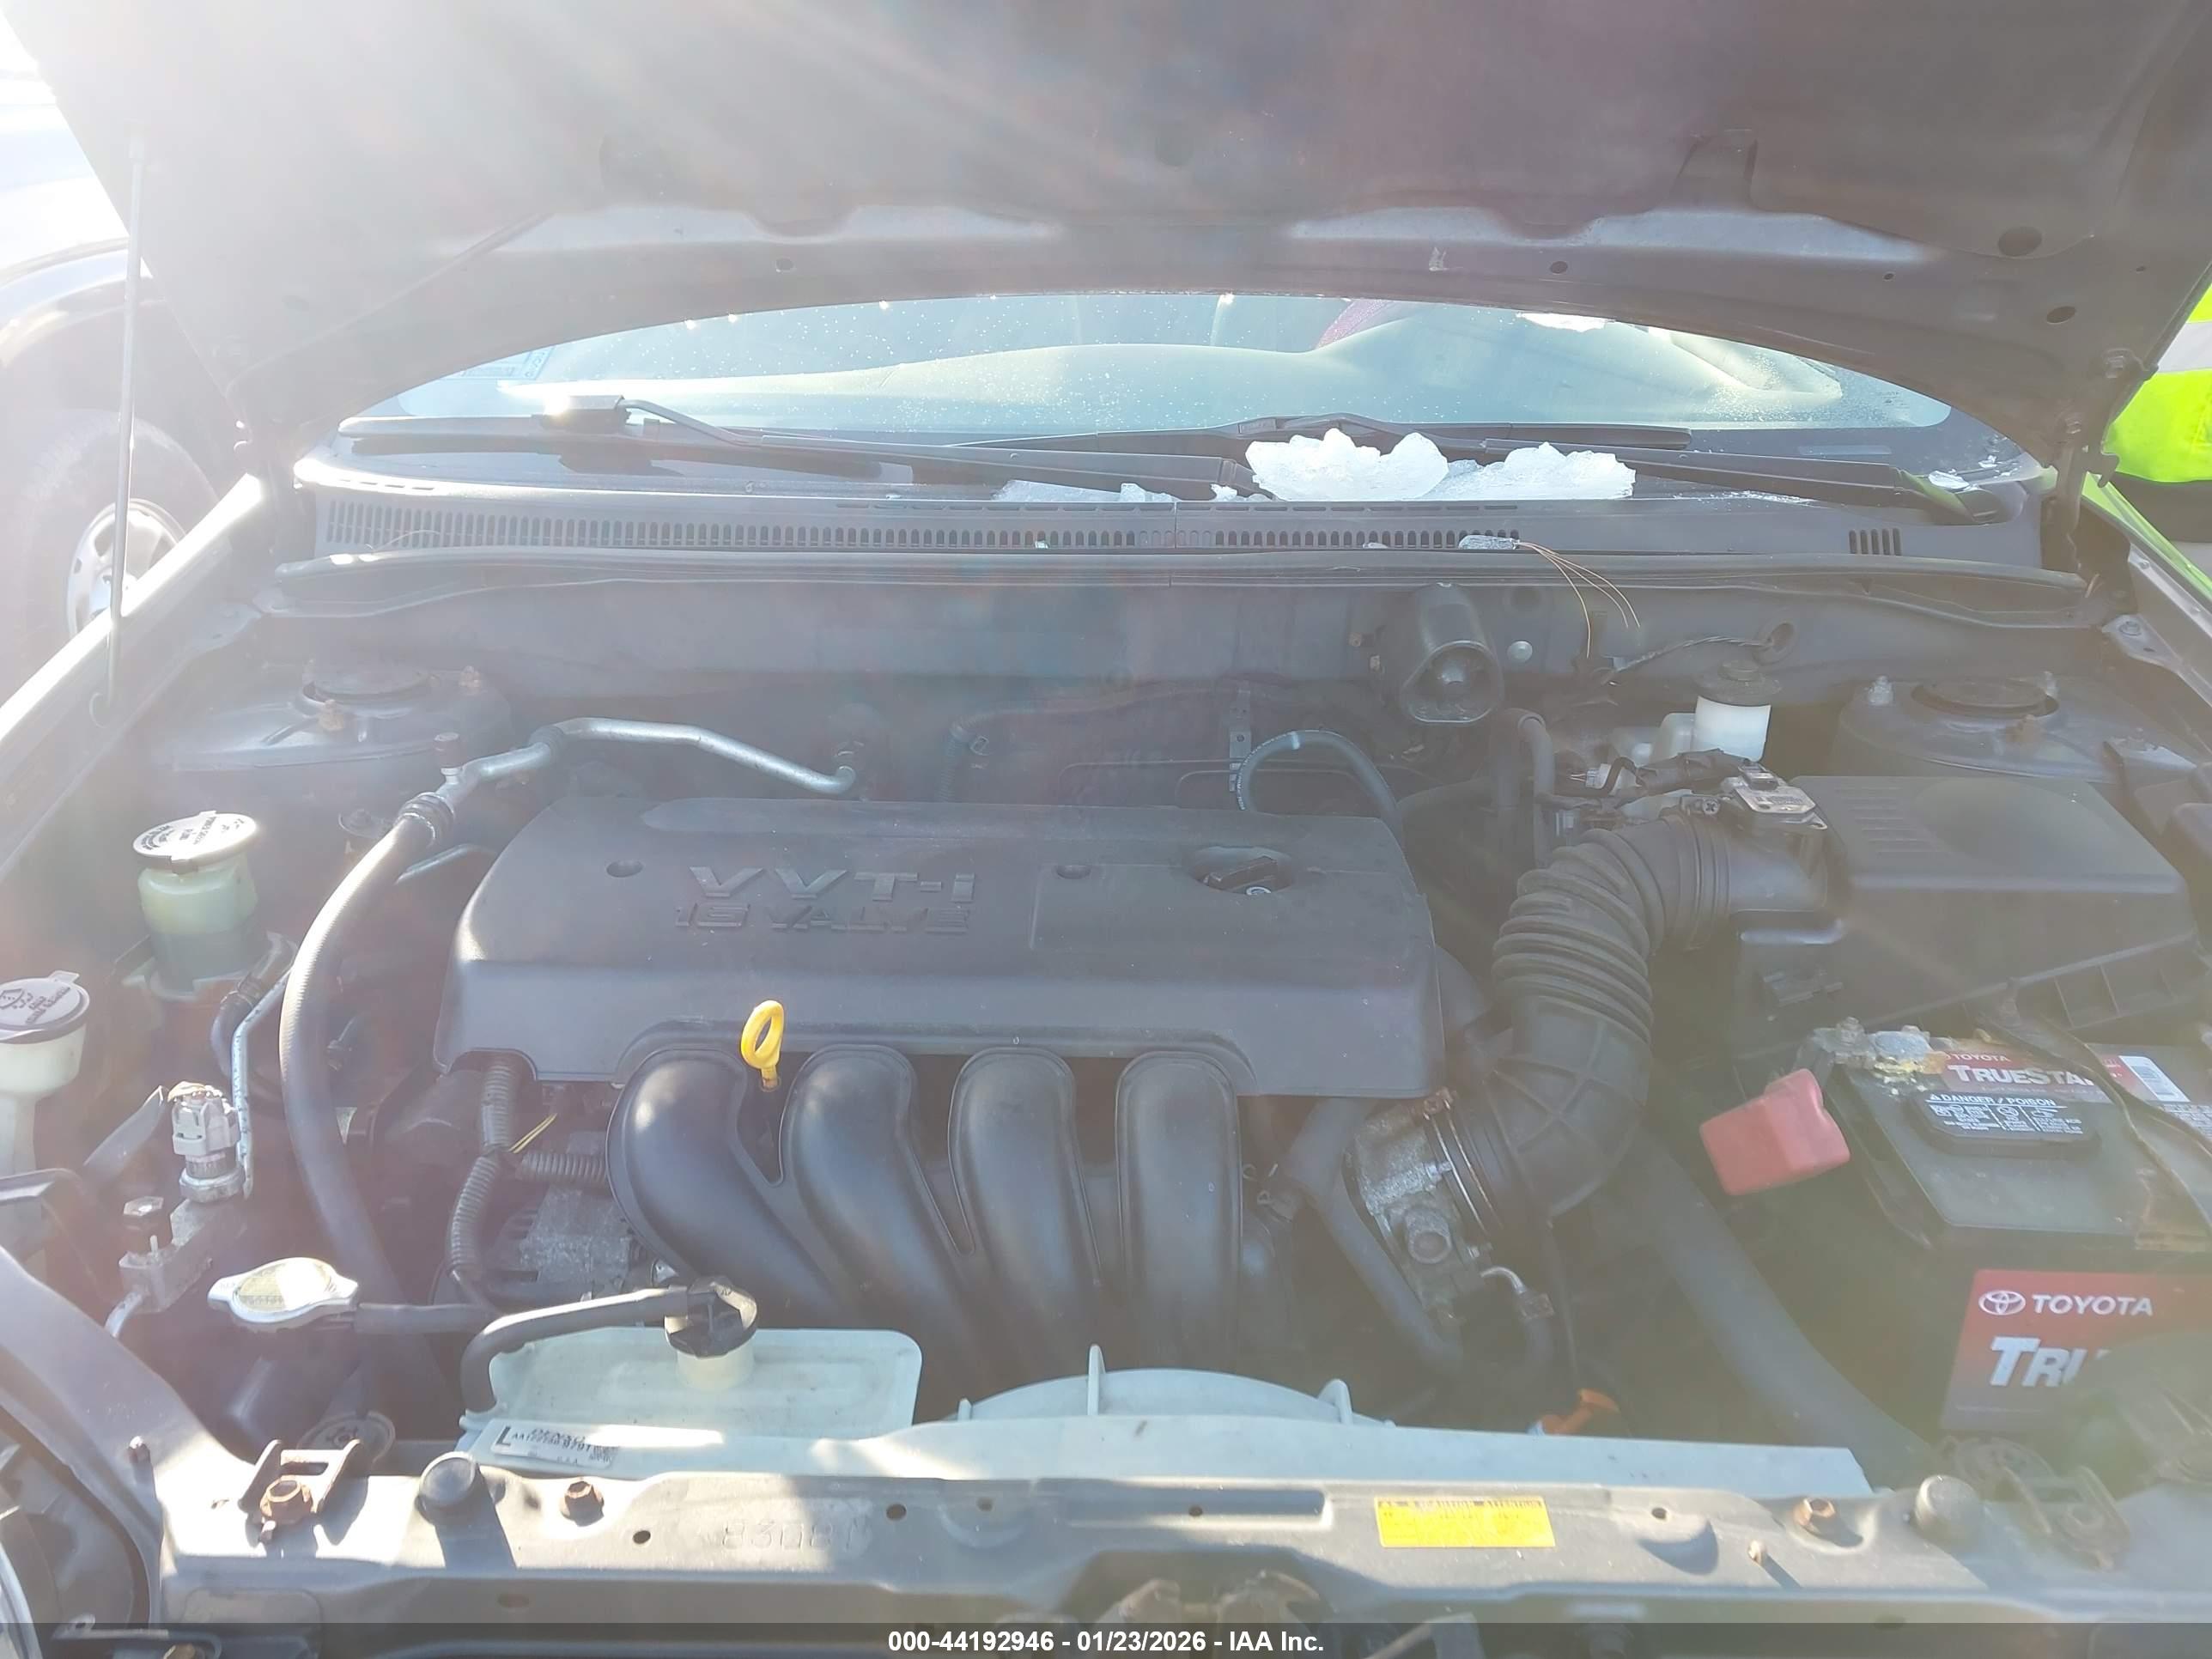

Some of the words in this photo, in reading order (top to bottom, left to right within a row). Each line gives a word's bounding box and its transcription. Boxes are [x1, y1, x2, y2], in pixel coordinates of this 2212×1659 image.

[1953, 1054, 2011, 1063] TOYOTA
[1941, 1093, 1994, 1104] DANGER
[2008, 1097, 2055, 1106] POISON
[2032, 1294, 2154, 1316] TOYOTA
[496, 1425, 512, 1446] L
